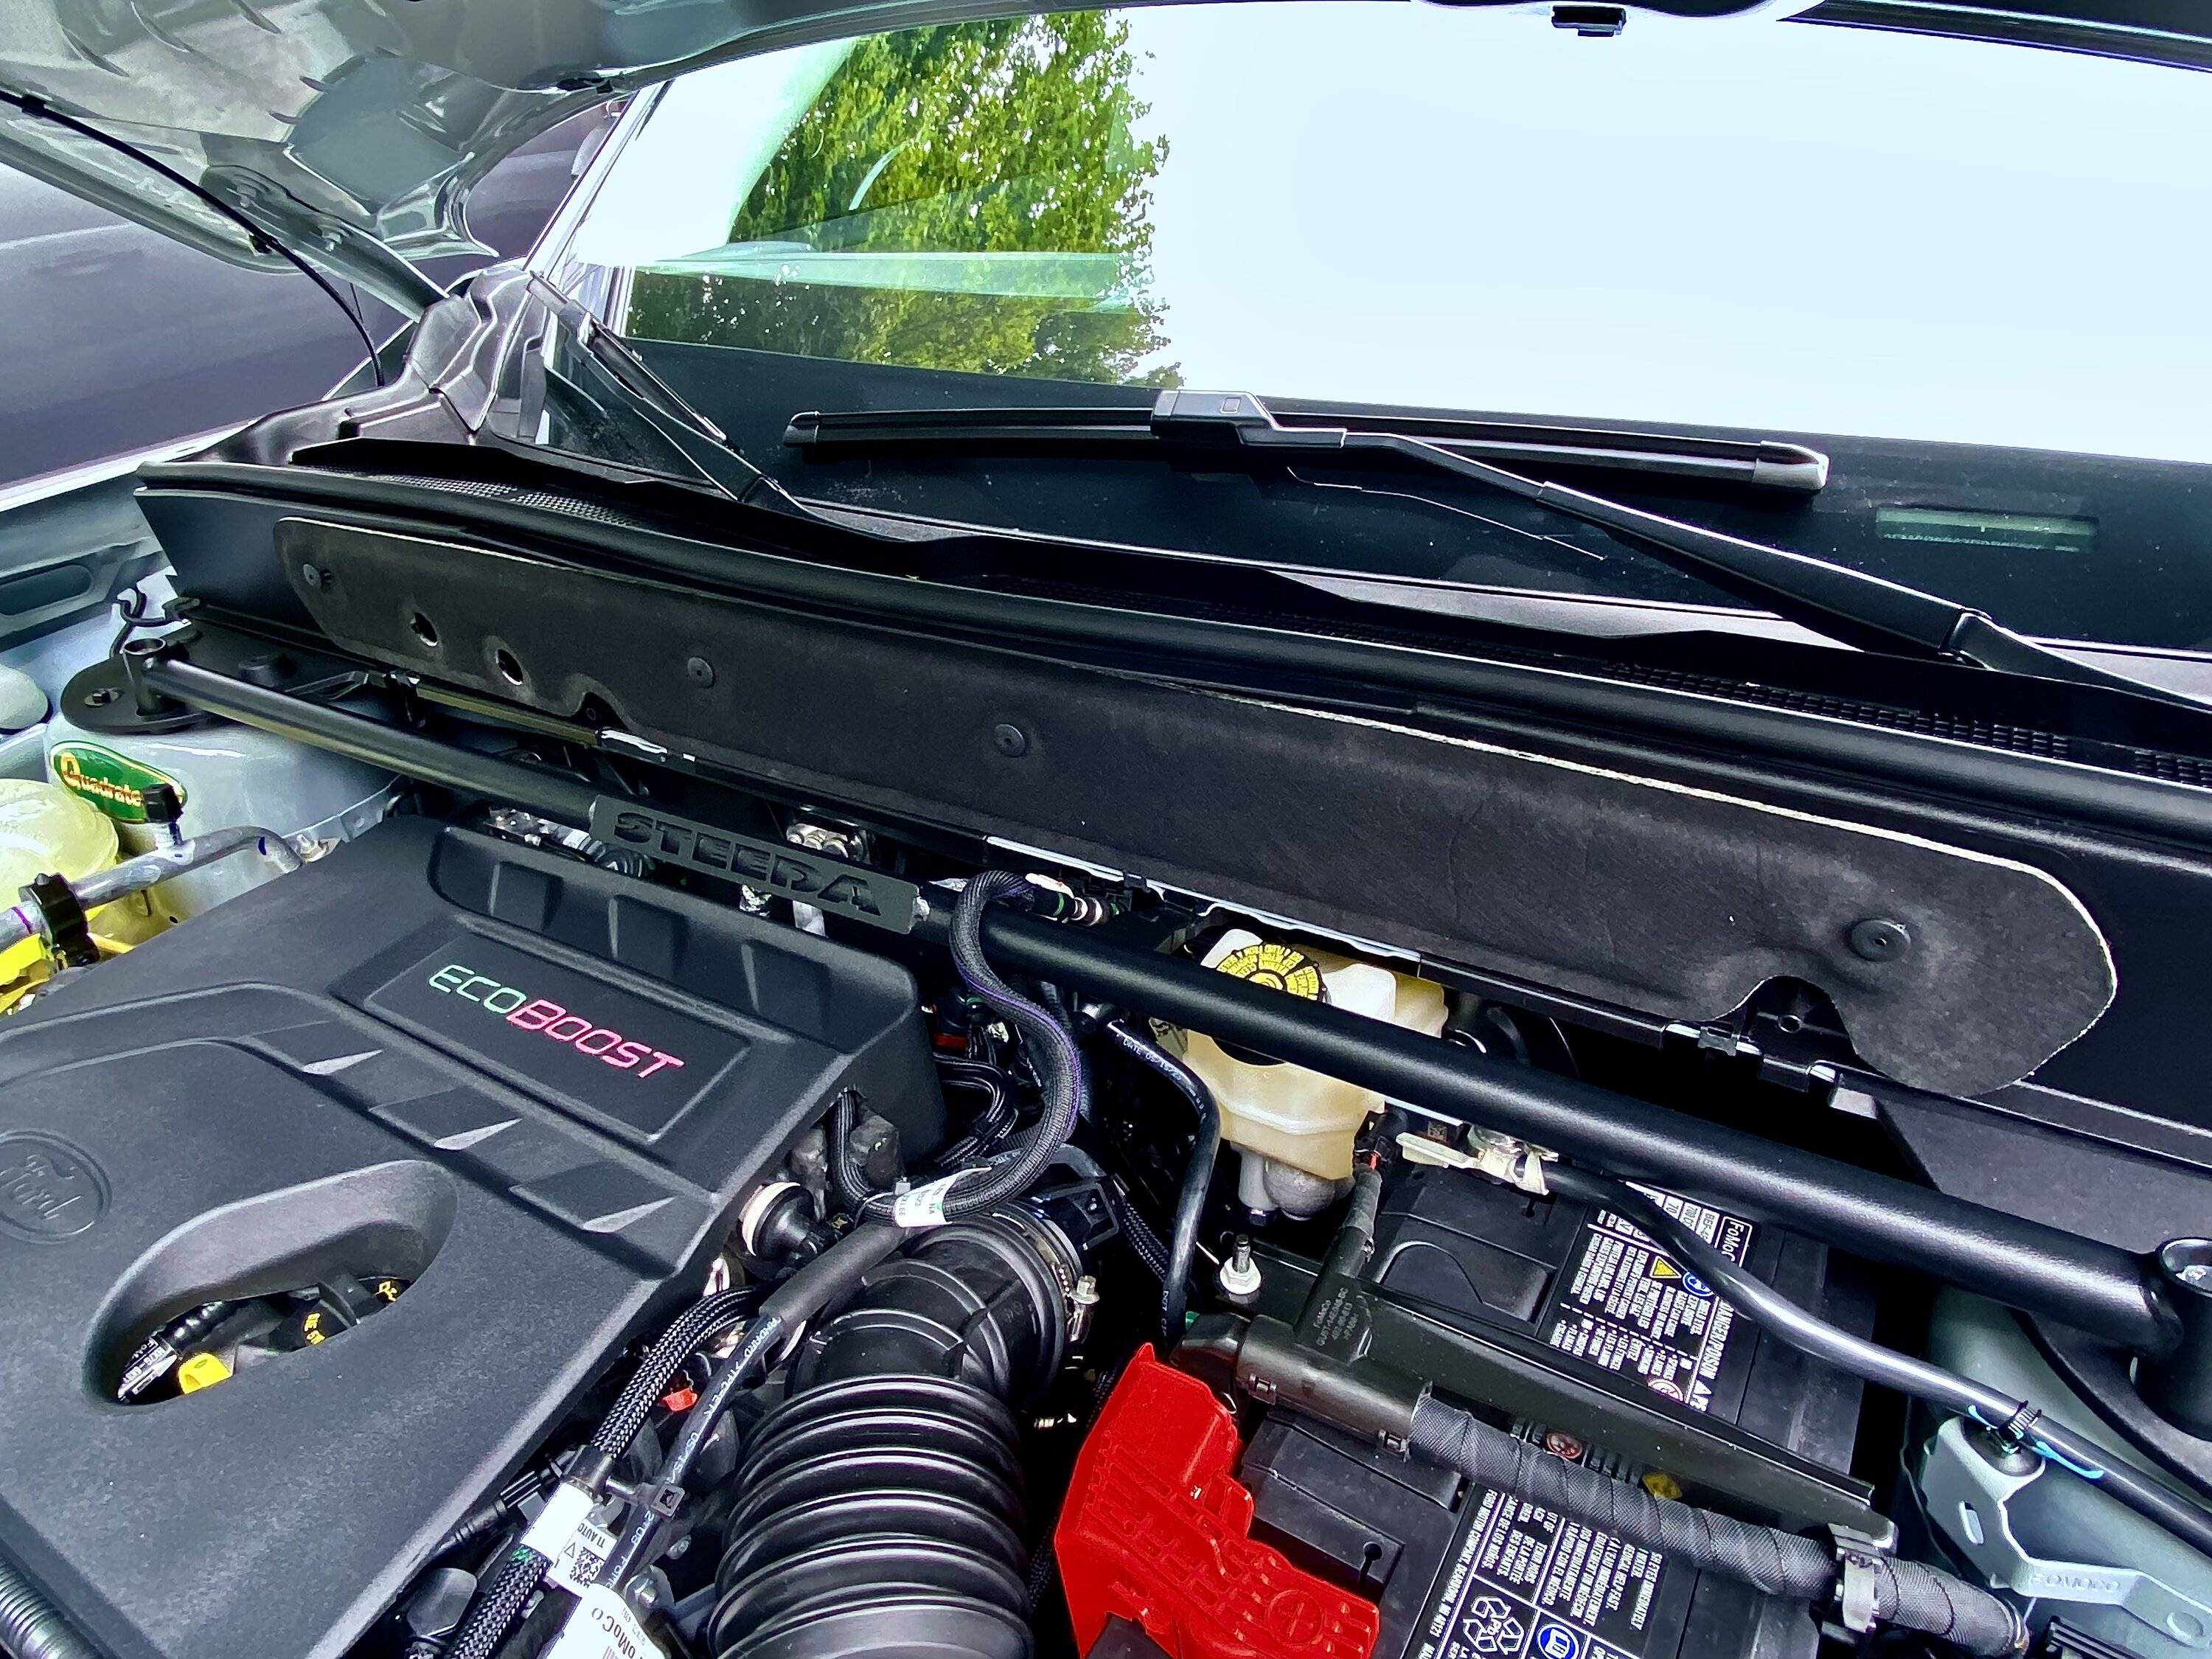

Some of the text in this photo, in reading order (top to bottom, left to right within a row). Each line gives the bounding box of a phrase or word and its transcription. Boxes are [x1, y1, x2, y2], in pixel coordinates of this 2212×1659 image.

[60, 752, 144, 807] Quadrate
[613, 812, 882, 917] STEEDA
[1664, 1202, 1680, 1214] 70
[1722, 1222, 1744, 1261] FoMoC
[1670, 1308, 1681, 1321] CAN
[1664, 1318, 1677, 1337] CAUSE
[1700, 1301, 1734, 1379] DANGER/POISON
[1483, 1489, 1498, 1509] FORD
[1472, 1506, 1490, 1532] MOTOR
[1498, 1517, 1510, 1530] DE
[1543, 1521, 1554, 1533] OF
[1492, 1528, 1506, 1545] LOS
[1509, 1529, 1523, 1545] DES
[1523, 1535, 1535, 1548] DE
[1561, 1526, 1579, 1554] RÁPIDO
[1519, 1545, 1531, 1557] LA
[1554, 1551, 1569, 1568] CON
[1523, 1561, 1540, 1584] HORS
[1580, 1573, 1595, 1586] UN
[1612, 1571, 1627, 1591] HELP
[1645, 1562, 1660, 1582] EYES
[1631, 1579, 1654, 1630] IMMEDIATELY
[591, 1607, 643, 1659] oMoCo
